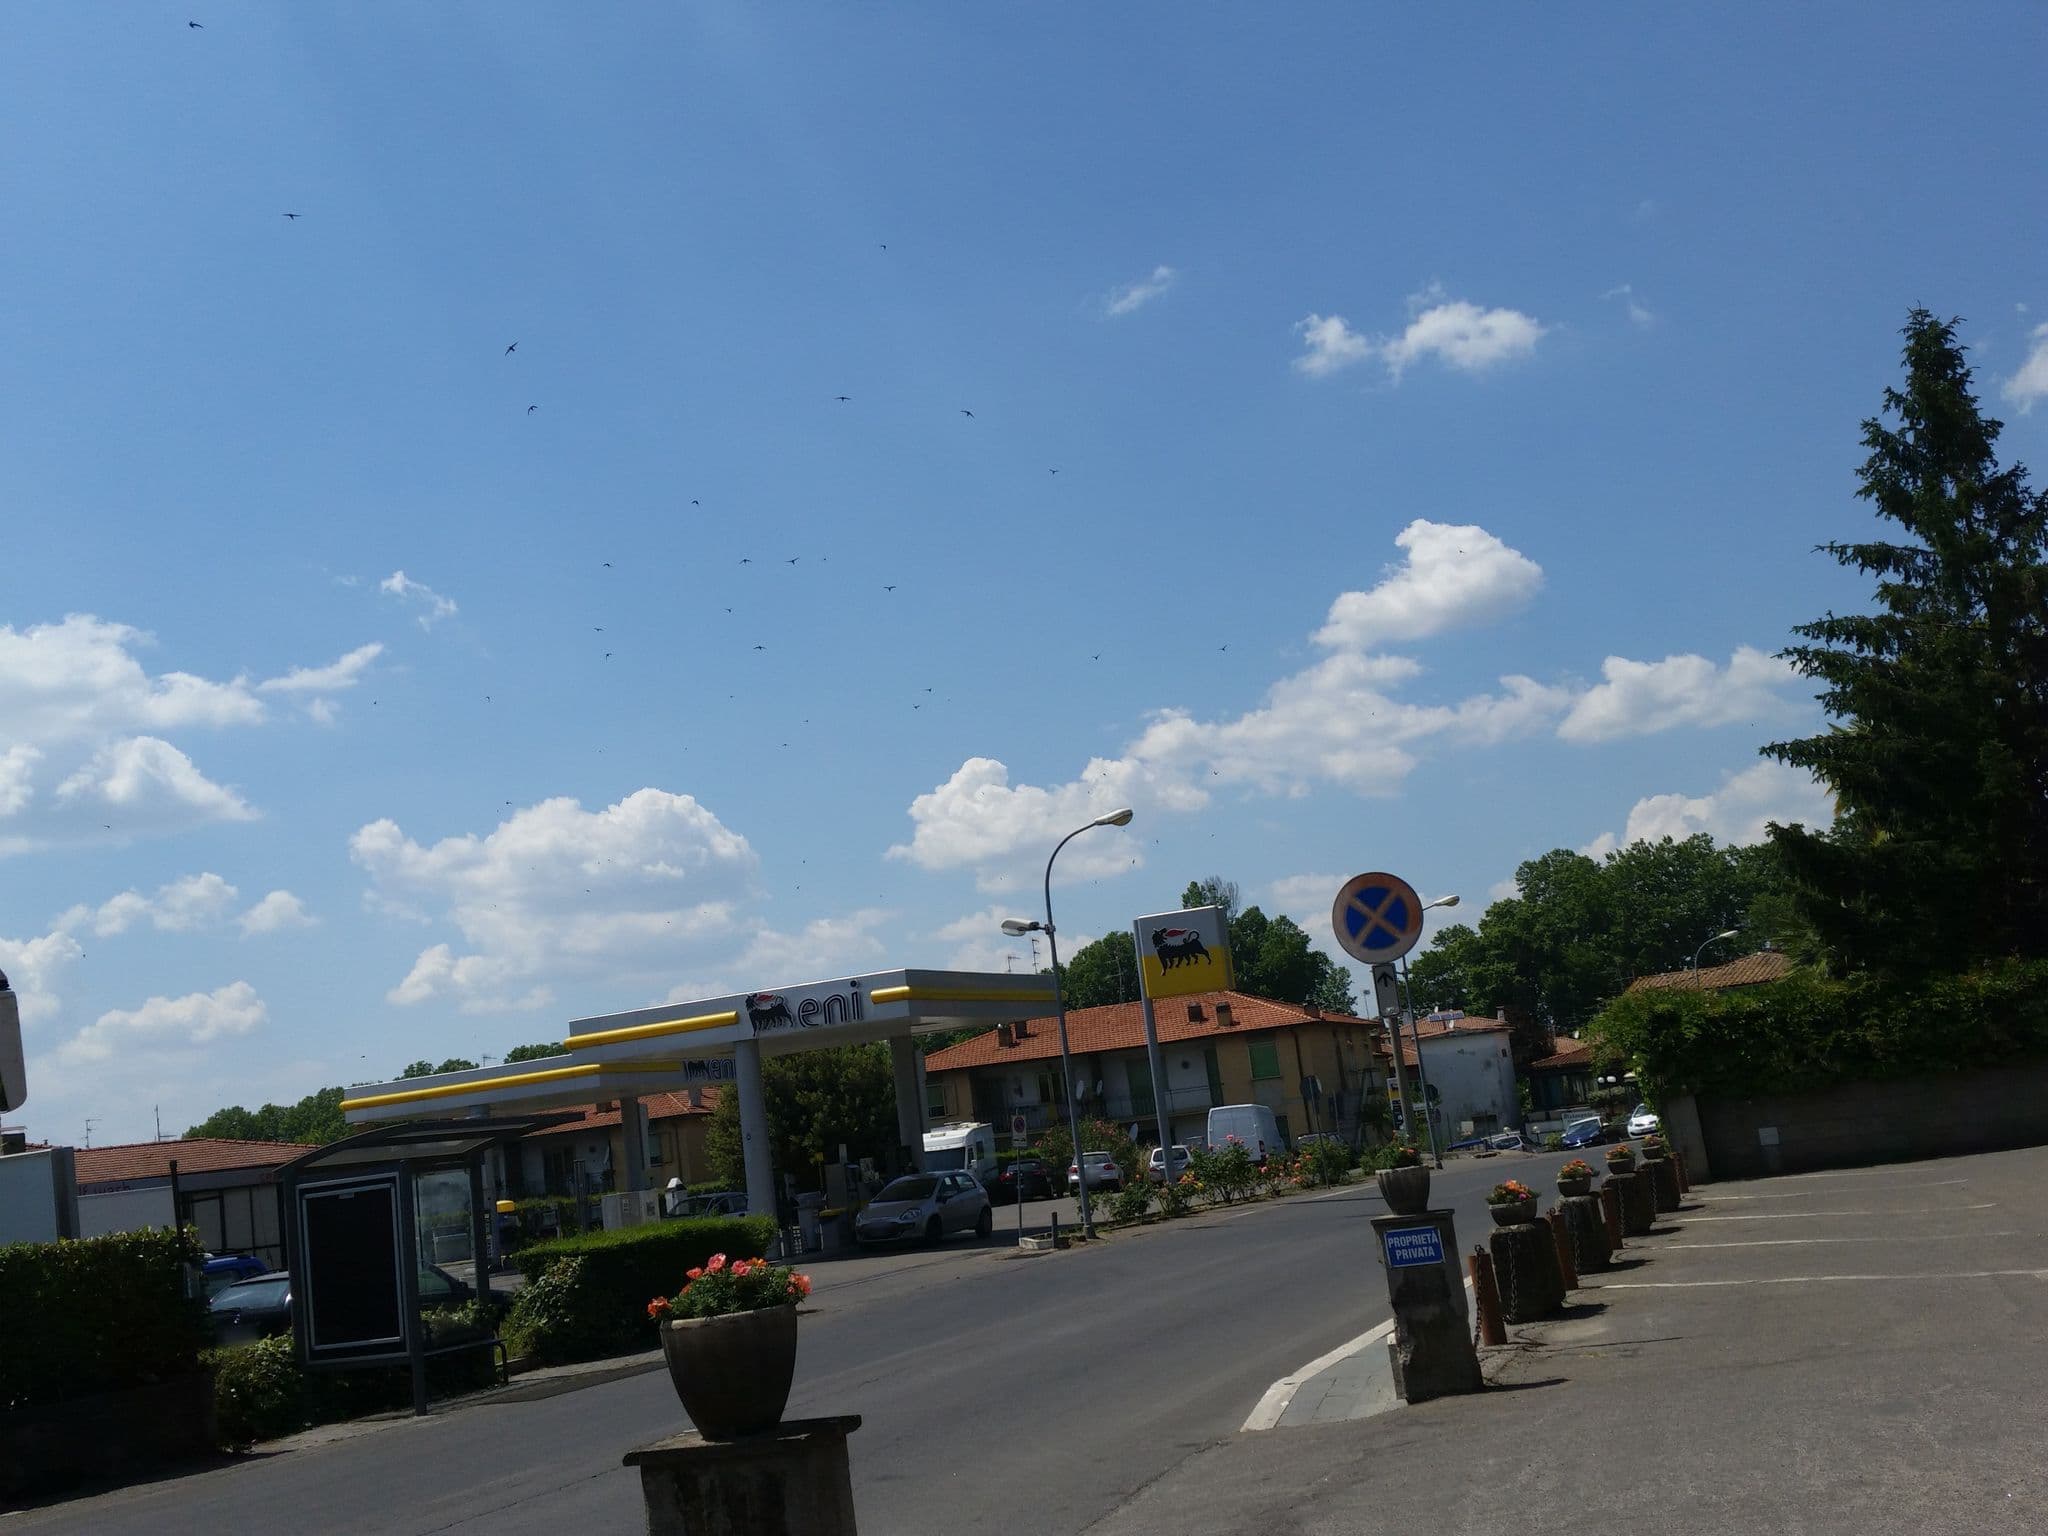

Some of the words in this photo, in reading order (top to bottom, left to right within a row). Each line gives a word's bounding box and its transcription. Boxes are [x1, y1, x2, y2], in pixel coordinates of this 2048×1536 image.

[798, 980, 862, 1028] eni
[1387, 1230, 1439, 1249] PROPRIETÀ
[1395, 1246, 1435, 1260] PRIVATA
